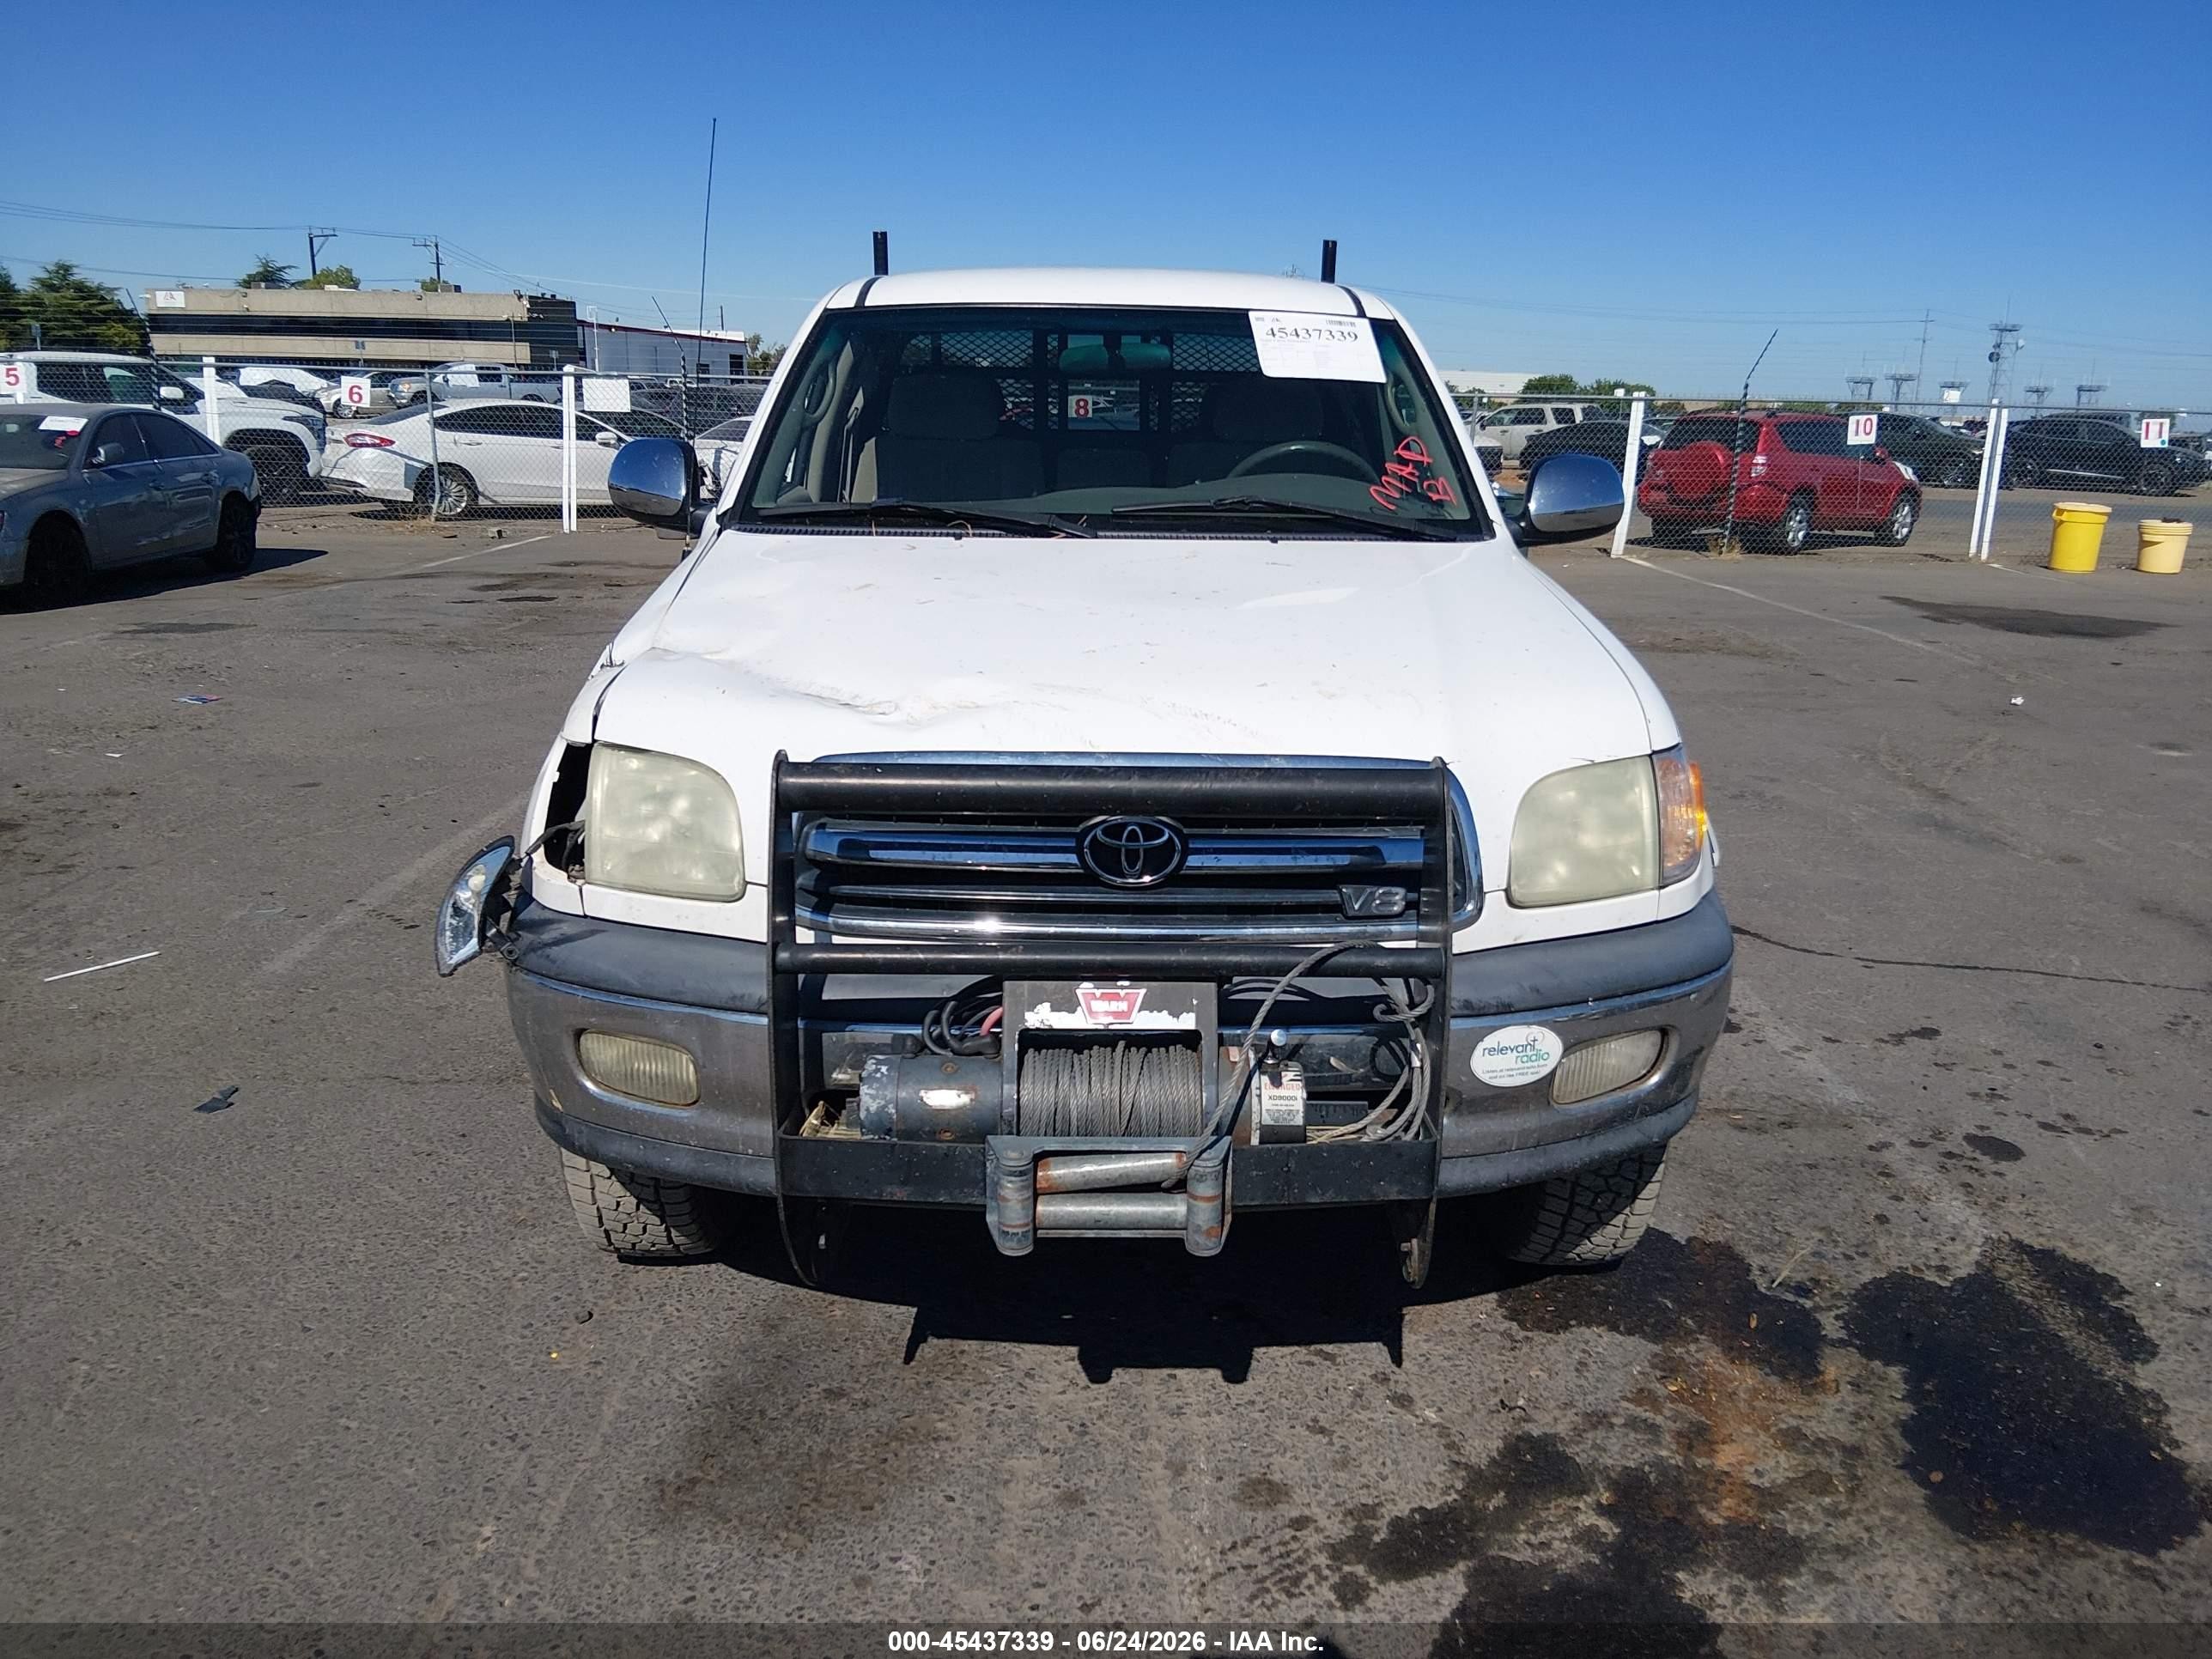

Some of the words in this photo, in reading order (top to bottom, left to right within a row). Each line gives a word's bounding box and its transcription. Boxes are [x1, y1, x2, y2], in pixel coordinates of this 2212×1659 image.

[1266, 327, 1358, 343] 45437339
[5, 367, 20, 386] 5
[348, 384, 363, 404] 6
[1074, 398, 1090, 417] 8
[1855, 417, 1874, 437] 10
[2144, 421, 2164, 441] 11
[1340, 885, 1407, 917] V8
[1482, 1036, 1539, 1057] relevant
[1515, 1048, 1551, 1065] radio
